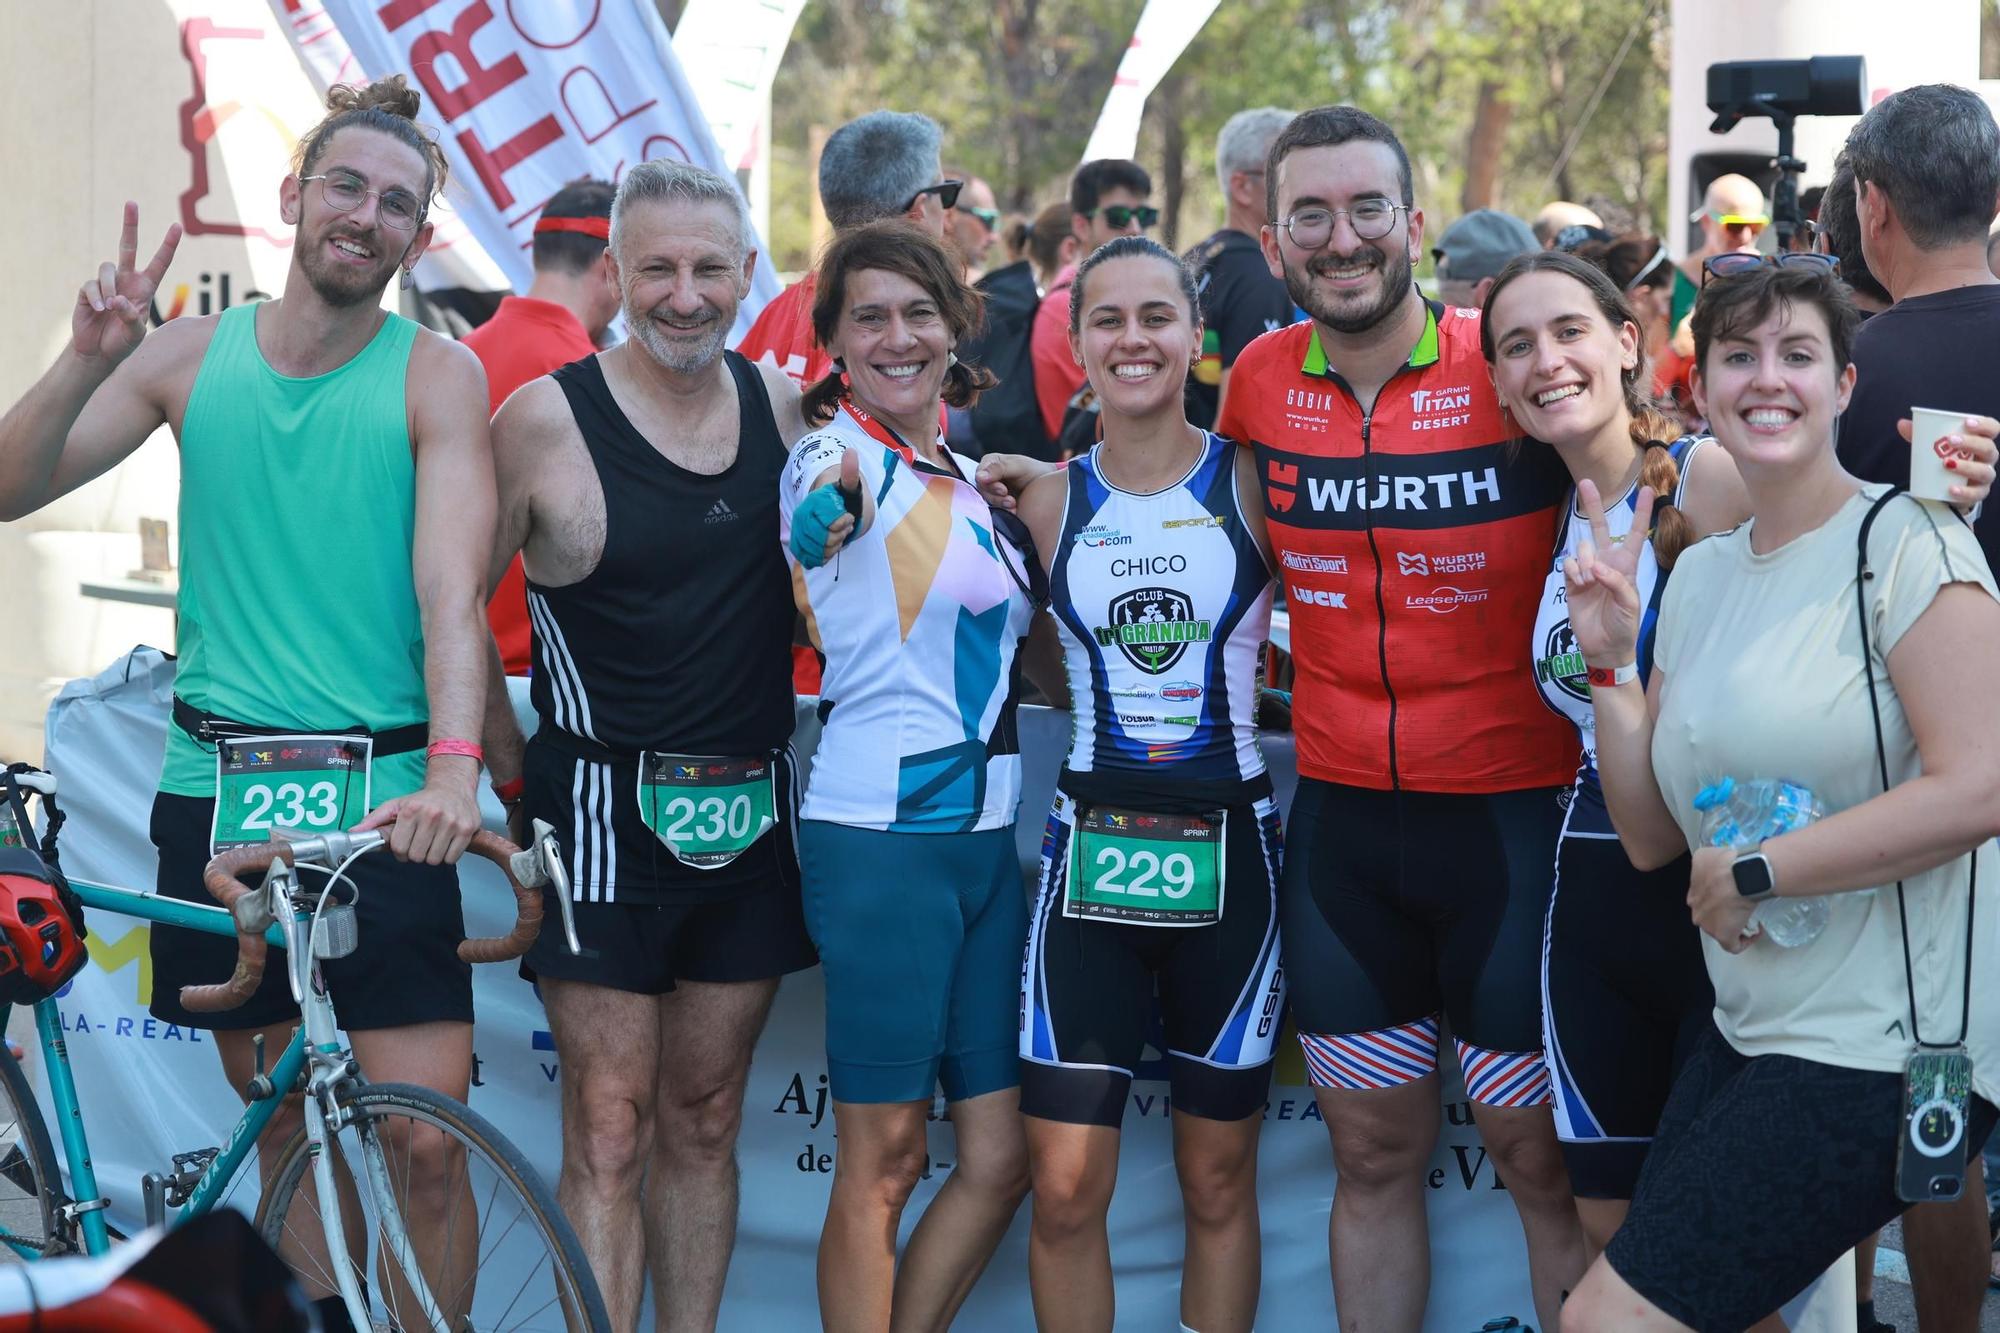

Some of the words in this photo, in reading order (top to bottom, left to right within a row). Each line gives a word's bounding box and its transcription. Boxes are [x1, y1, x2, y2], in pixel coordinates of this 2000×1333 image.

[150, 273, 272, 328] vil
[1287, 389, 1332, 411] GOBIK
[1411, 390, 1470, 413] TITAN
[1435, 385, 1470, 397] GARMIN
[1412, 414, 1471, 431] DESERT
[1307, 467, 1501, 512] WÜRTH
[1111, 555, 1187, 577] CHICO
[1434, 563, 1486, 574] MODYF
[1135, 591, 1164, 602] CLUB
[1292, 585, 1348, 609] LUCK
[1405, 592, 1488, 605] LeasePlan
[1120, 715, 1155, 723] VOLSUR
[327, 757, 354, 767] SPRIN
[745, 768, 765, 778] SPRINT
[241, 781, 338, 830] 233
[665, 794, 751, 842] 230
[1183, 829, 1210, 837] SPRINT
[1094, 847, 1195, 899] 229
[797, 1144, 832, 1174] de
